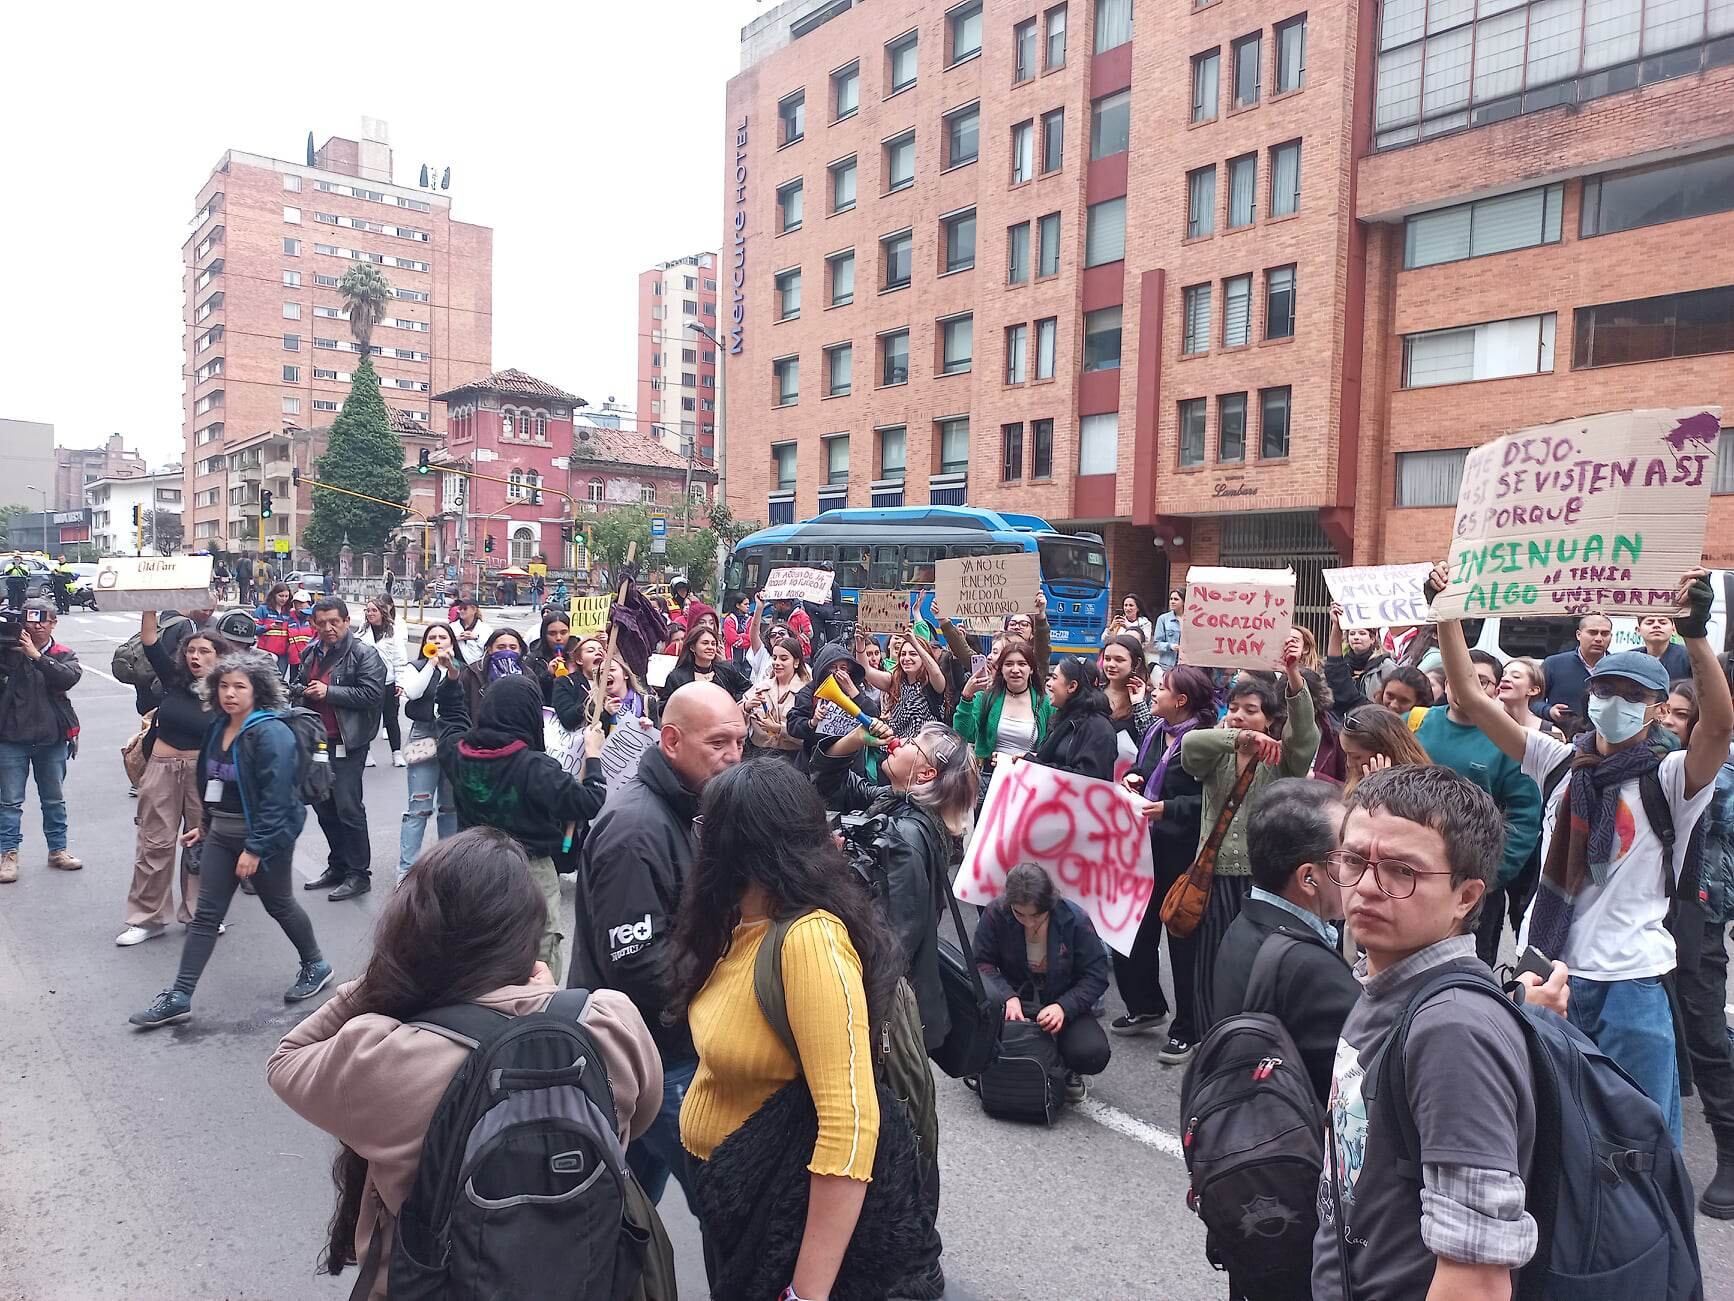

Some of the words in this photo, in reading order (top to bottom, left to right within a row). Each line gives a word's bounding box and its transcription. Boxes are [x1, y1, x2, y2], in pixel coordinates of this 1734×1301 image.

[735, 115, 748, 204] HOTEL
[1535, 457, 1638, 495] VISTEN
[1482, 496, 1585, 535] PORQUE
[961, 560, 974, 574] YA
[976, 560, 992, 571] NO
[1452, 532, 1643, 585] INSINUAN
[961, 574, 1007, 588] TENEMOS
[1463, 581, 1540, 611] ALGO
[1342, 602, 1371, 624] TE
[1213, 633, 1265, 656] IVÁN
[973, 777, 1077, 880] NO
[608, 913, 653, 949] red
